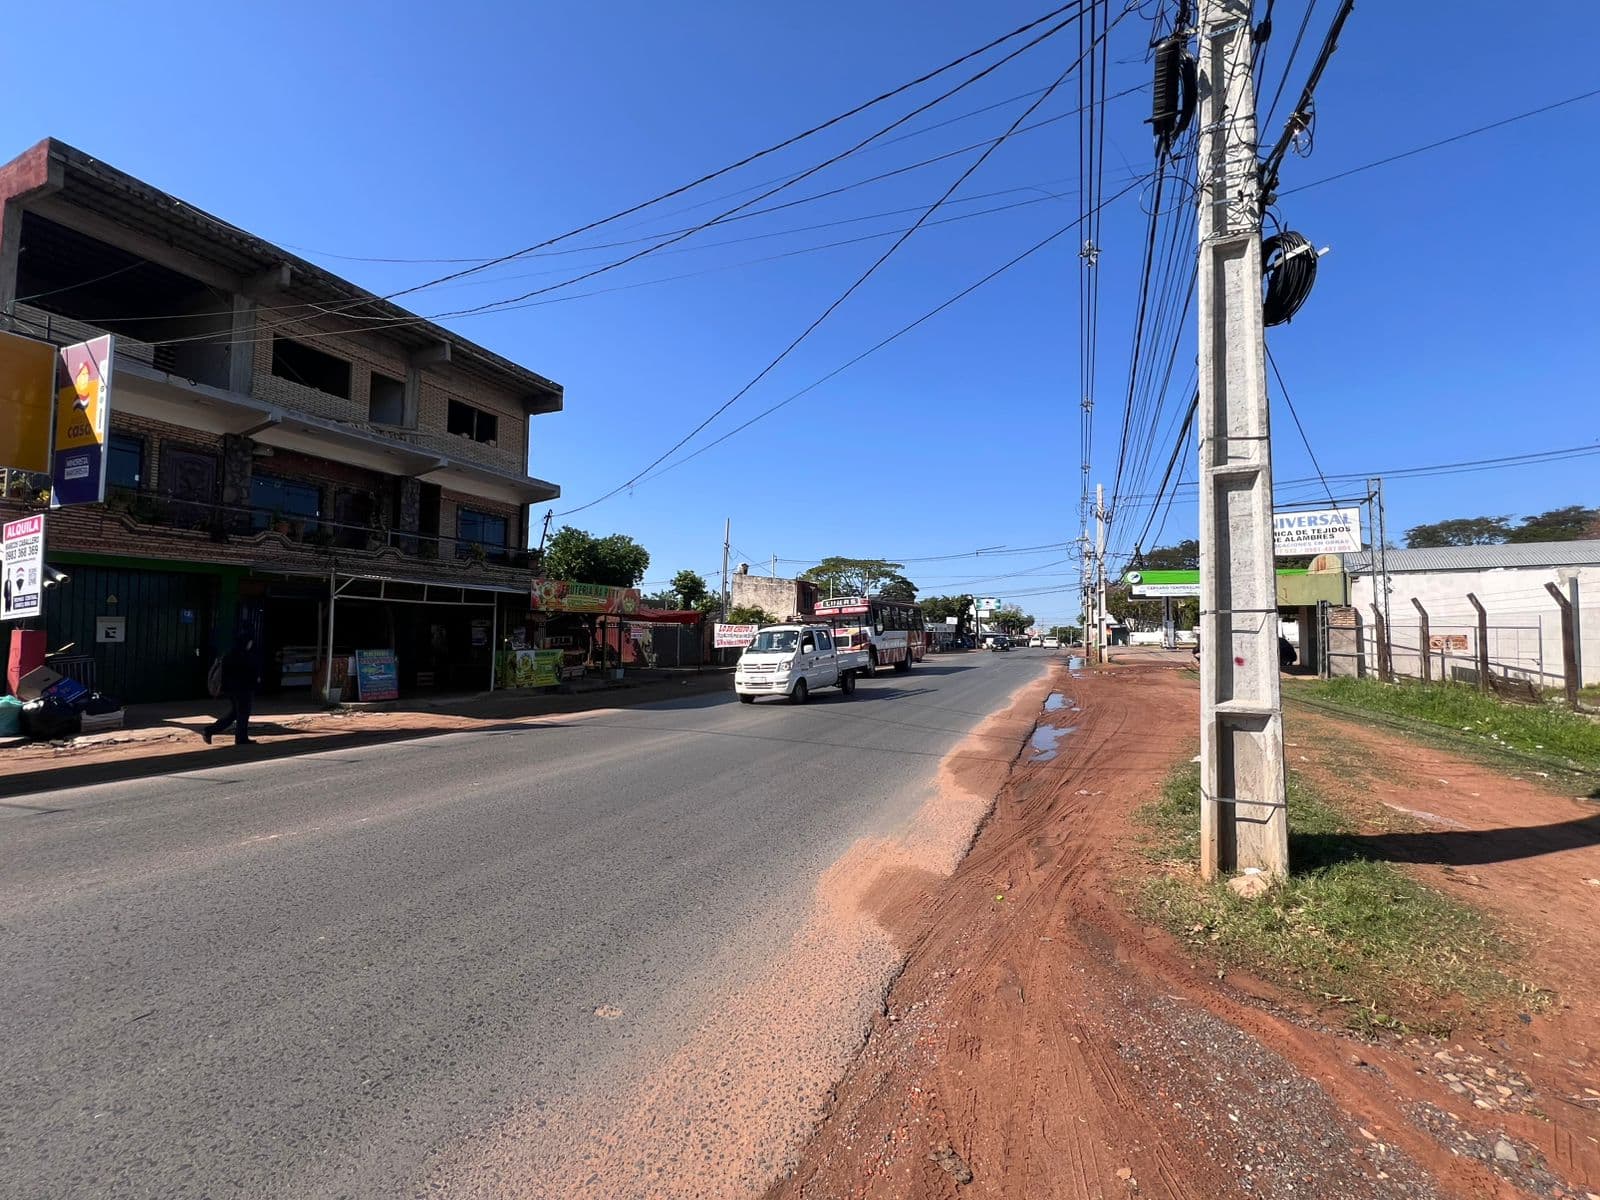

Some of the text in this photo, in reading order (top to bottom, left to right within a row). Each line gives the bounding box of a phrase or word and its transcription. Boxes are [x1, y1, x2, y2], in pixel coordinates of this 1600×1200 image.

[7, 518, 39, 539] ALQUILA
[1311, 526, 1351, 534] TEJIDOS
[1285, 534, 1335, 542] ALAMBRES
